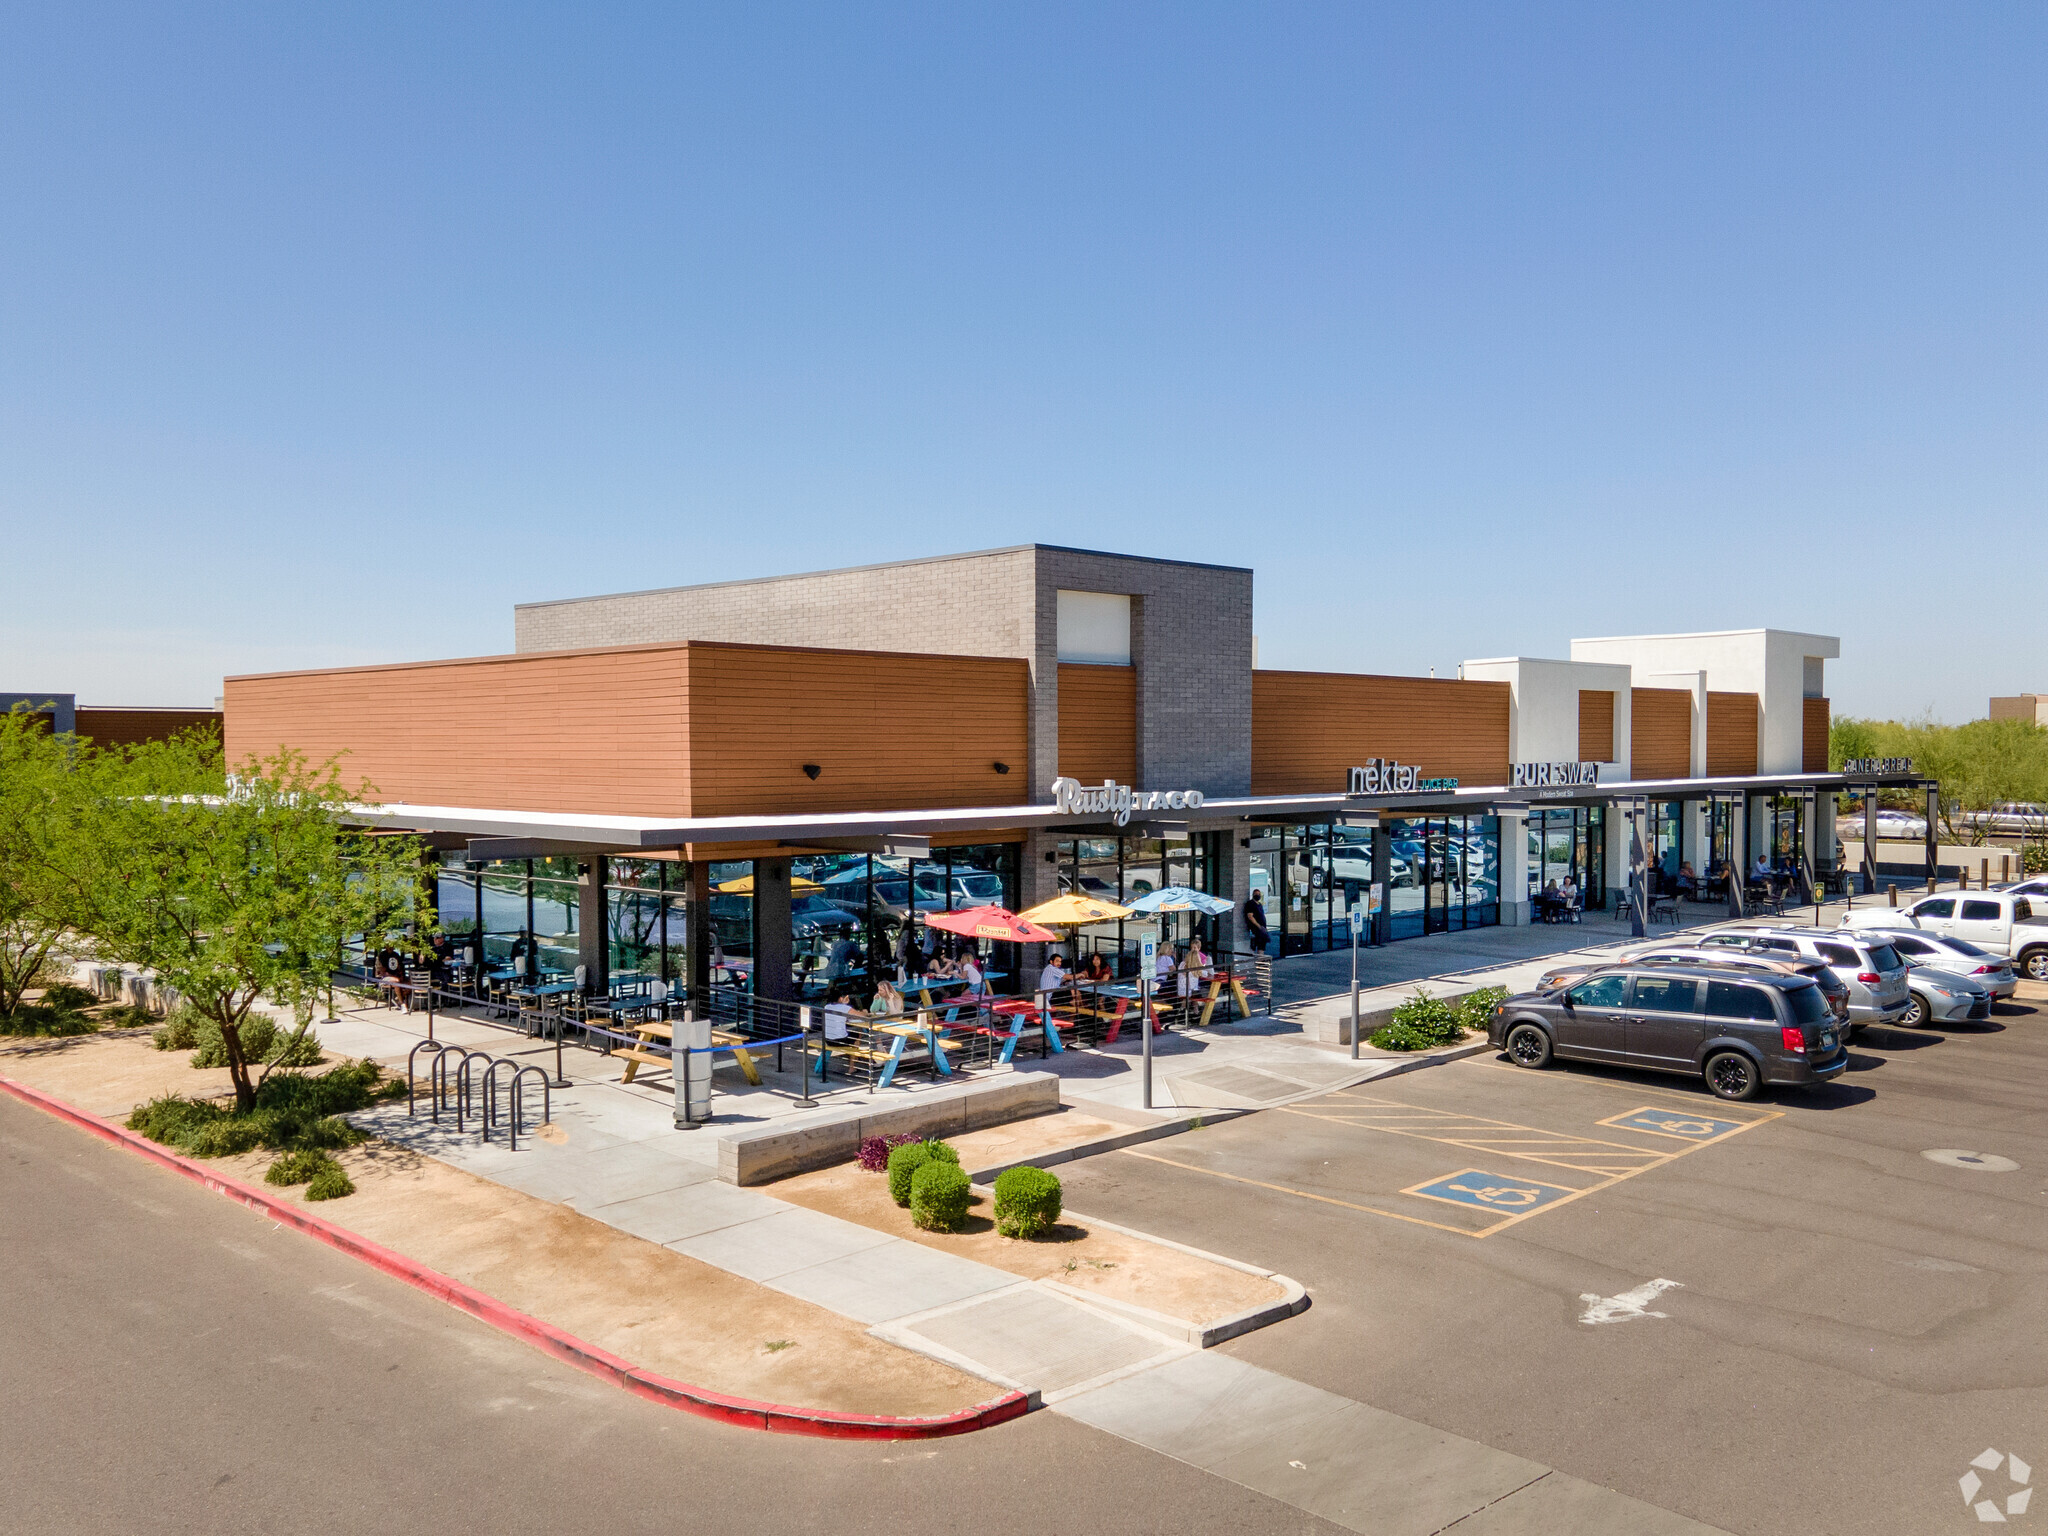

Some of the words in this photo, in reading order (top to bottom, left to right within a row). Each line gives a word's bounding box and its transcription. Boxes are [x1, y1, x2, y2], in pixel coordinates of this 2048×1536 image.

[1846, 758, 1882, 774] PANERA
[1884, 757, 1913, 772] BREAD
[1420, 778, 1442, 790] JUICE
[1442, 778, 1459, 789] BAR
[1051, 776, 1132, 827] Rusty
[1131, 790, 1204, 811] TACO
